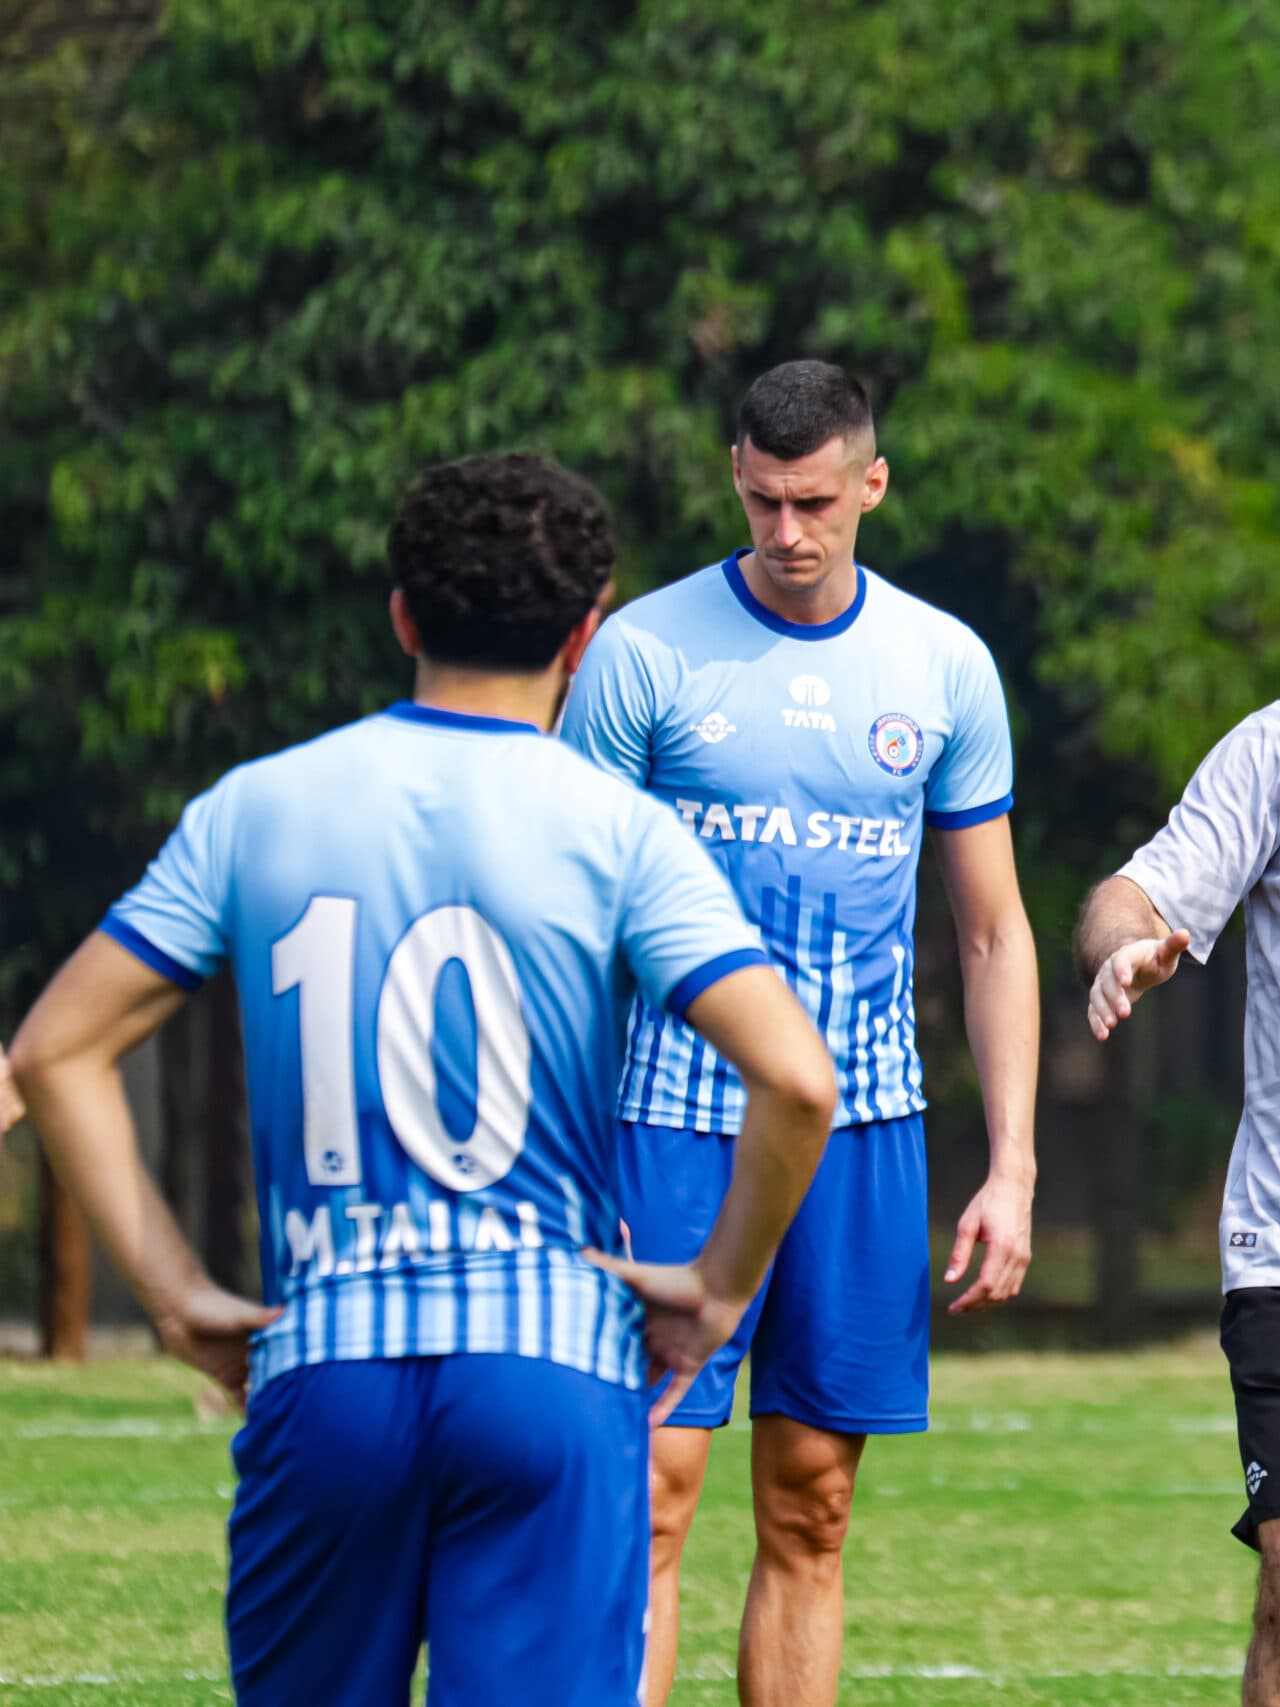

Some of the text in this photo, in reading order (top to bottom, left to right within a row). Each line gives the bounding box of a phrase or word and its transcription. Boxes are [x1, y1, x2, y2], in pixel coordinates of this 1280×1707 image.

[781, 708, 836, 732] TATA
[676, 798, 911, 857] TATA STEEL
[271, 895, 531, 1193] 10
